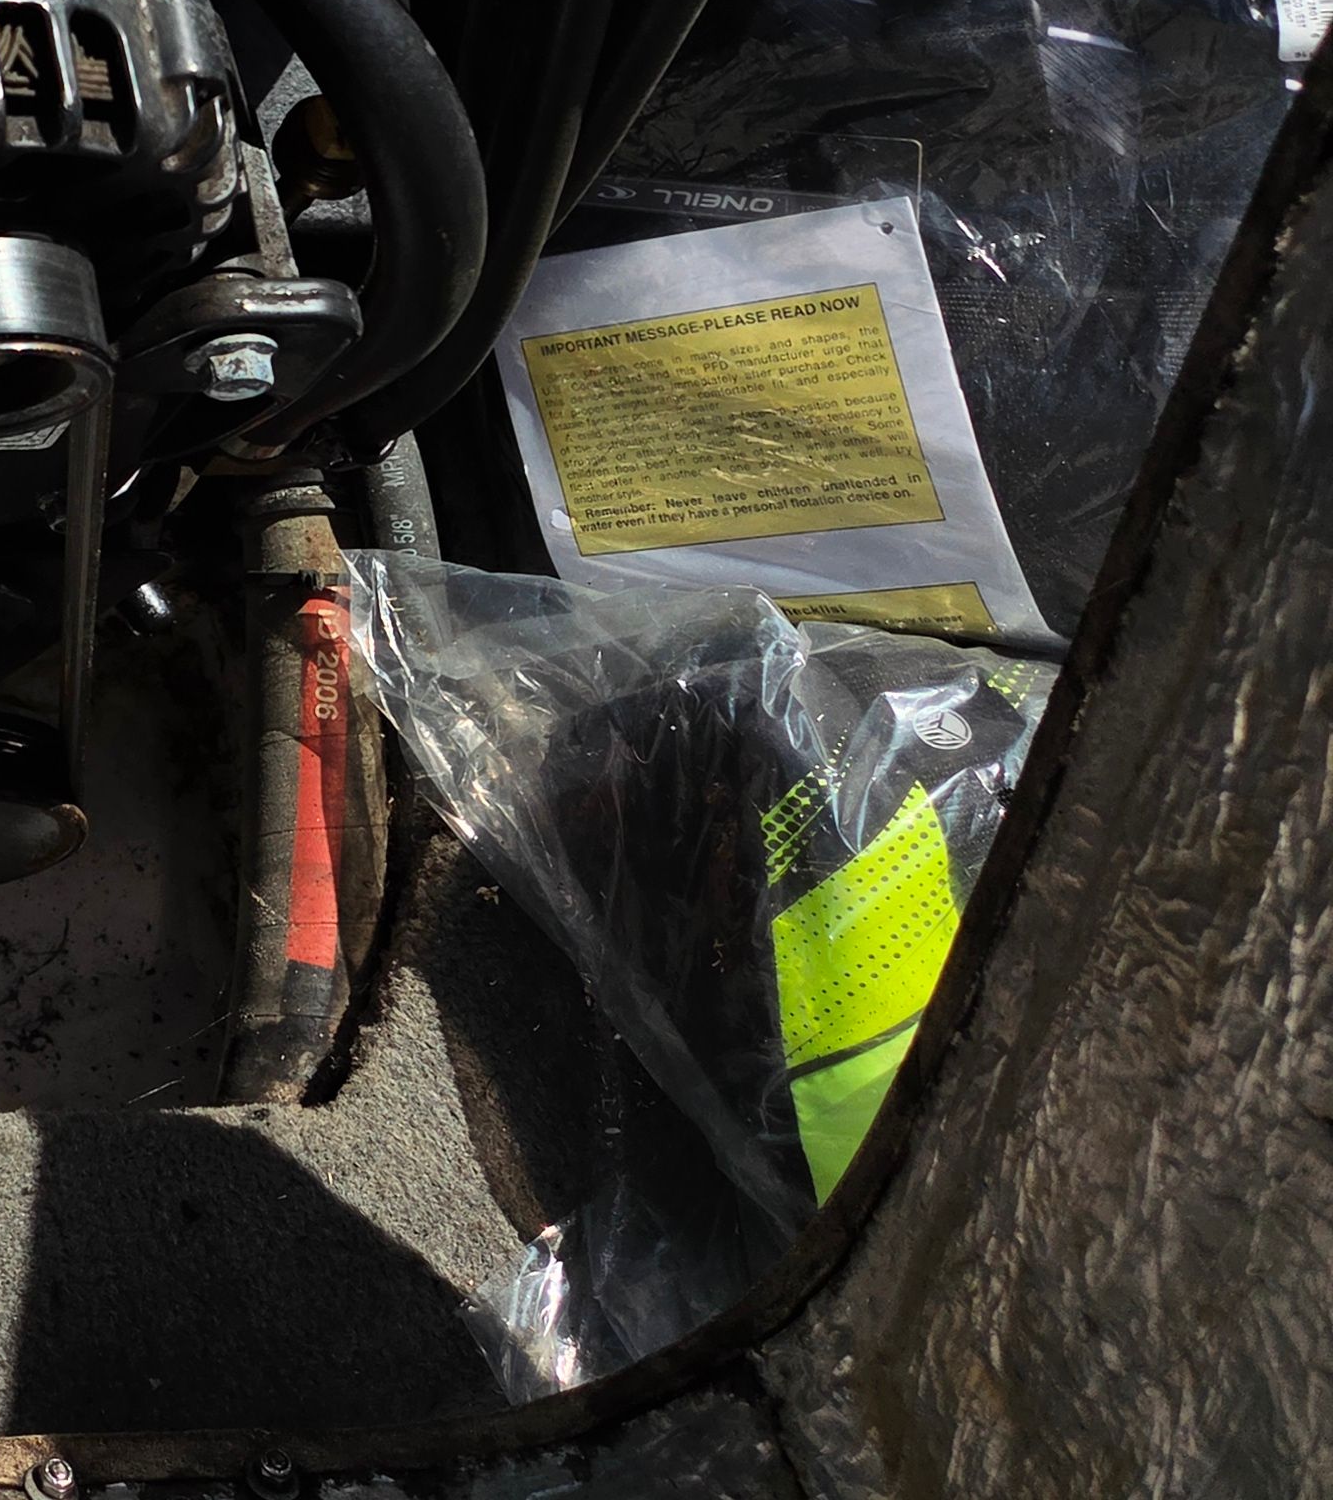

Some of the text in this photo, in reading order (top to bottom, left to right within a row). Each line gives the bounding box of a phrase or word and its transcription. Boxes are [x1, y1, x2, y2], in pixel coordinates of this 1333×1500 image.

[652, 187, 774, 214] O'NEILL
[540, 295, 860, 356] IMPORTANT MESSAGE-PLEASE READ NOW
[633, 359, 663, 369] come
[690, 350, 722, 363] many
[729, 343, 760, 355] sizes
[768, 338, 792, 349] and
[801, 330, 850, 347] shapes,
[859, 325, 879, 336] the
[648, 369, 669, 379] and
[703, 360, 728, 371] PFD
[735, 348, 814, 367] manufacturer
[823, 344, 851, 357] urge
[858, 337, 883, 349] that
[744, 367, 771, 379] after
[845, 351, 886, 365] Check
[570, 406, 605, 417] proper
[612, 399, 648, 412] weight
[697, 382, 764, 398] comfortable
[795, 375, 818, 385] and
[826, 365, 890, 383] especially
[791, 399, 838, 414] position
[844, 391, 896, 405] because
[792, 429, 811, 438] the
[867, 417, 903, 429] Some
[827, 407, 883, 423] tendency
[566, 467, 609, 479] children
[615, 463, 639, 473] float
[645, 460, 669, 469] best
[693, 456, 713, 464] one
[888, 430, 907, 440] will
[823, 451, 850, 461] work
[895, 444, 912, 456] try
[573, 492, 614, 503] another
[579, 520, 613, 531] water
[615, 518, 644, 527] even
[658, 512, 686, 525] they
[688, 508, 719, 519] have
[732, 500, 788, 517] personal
[846, 489, 889, 502] device
[892, 489, 914, 497] on.
[584, 501, 655, 517] Remember:
[665, 496, 702, 508] Never
[713, 491, 746, 503] leave
[757, 484, 810, 498] children
[820, 474, 896, 491] unattended
[391, 512, 416, 543] 5/8"
[781, 604, 847, 618] hecklist
[919, 614, 963, 624] to wear
[313, 650, 339, 721] 2006
